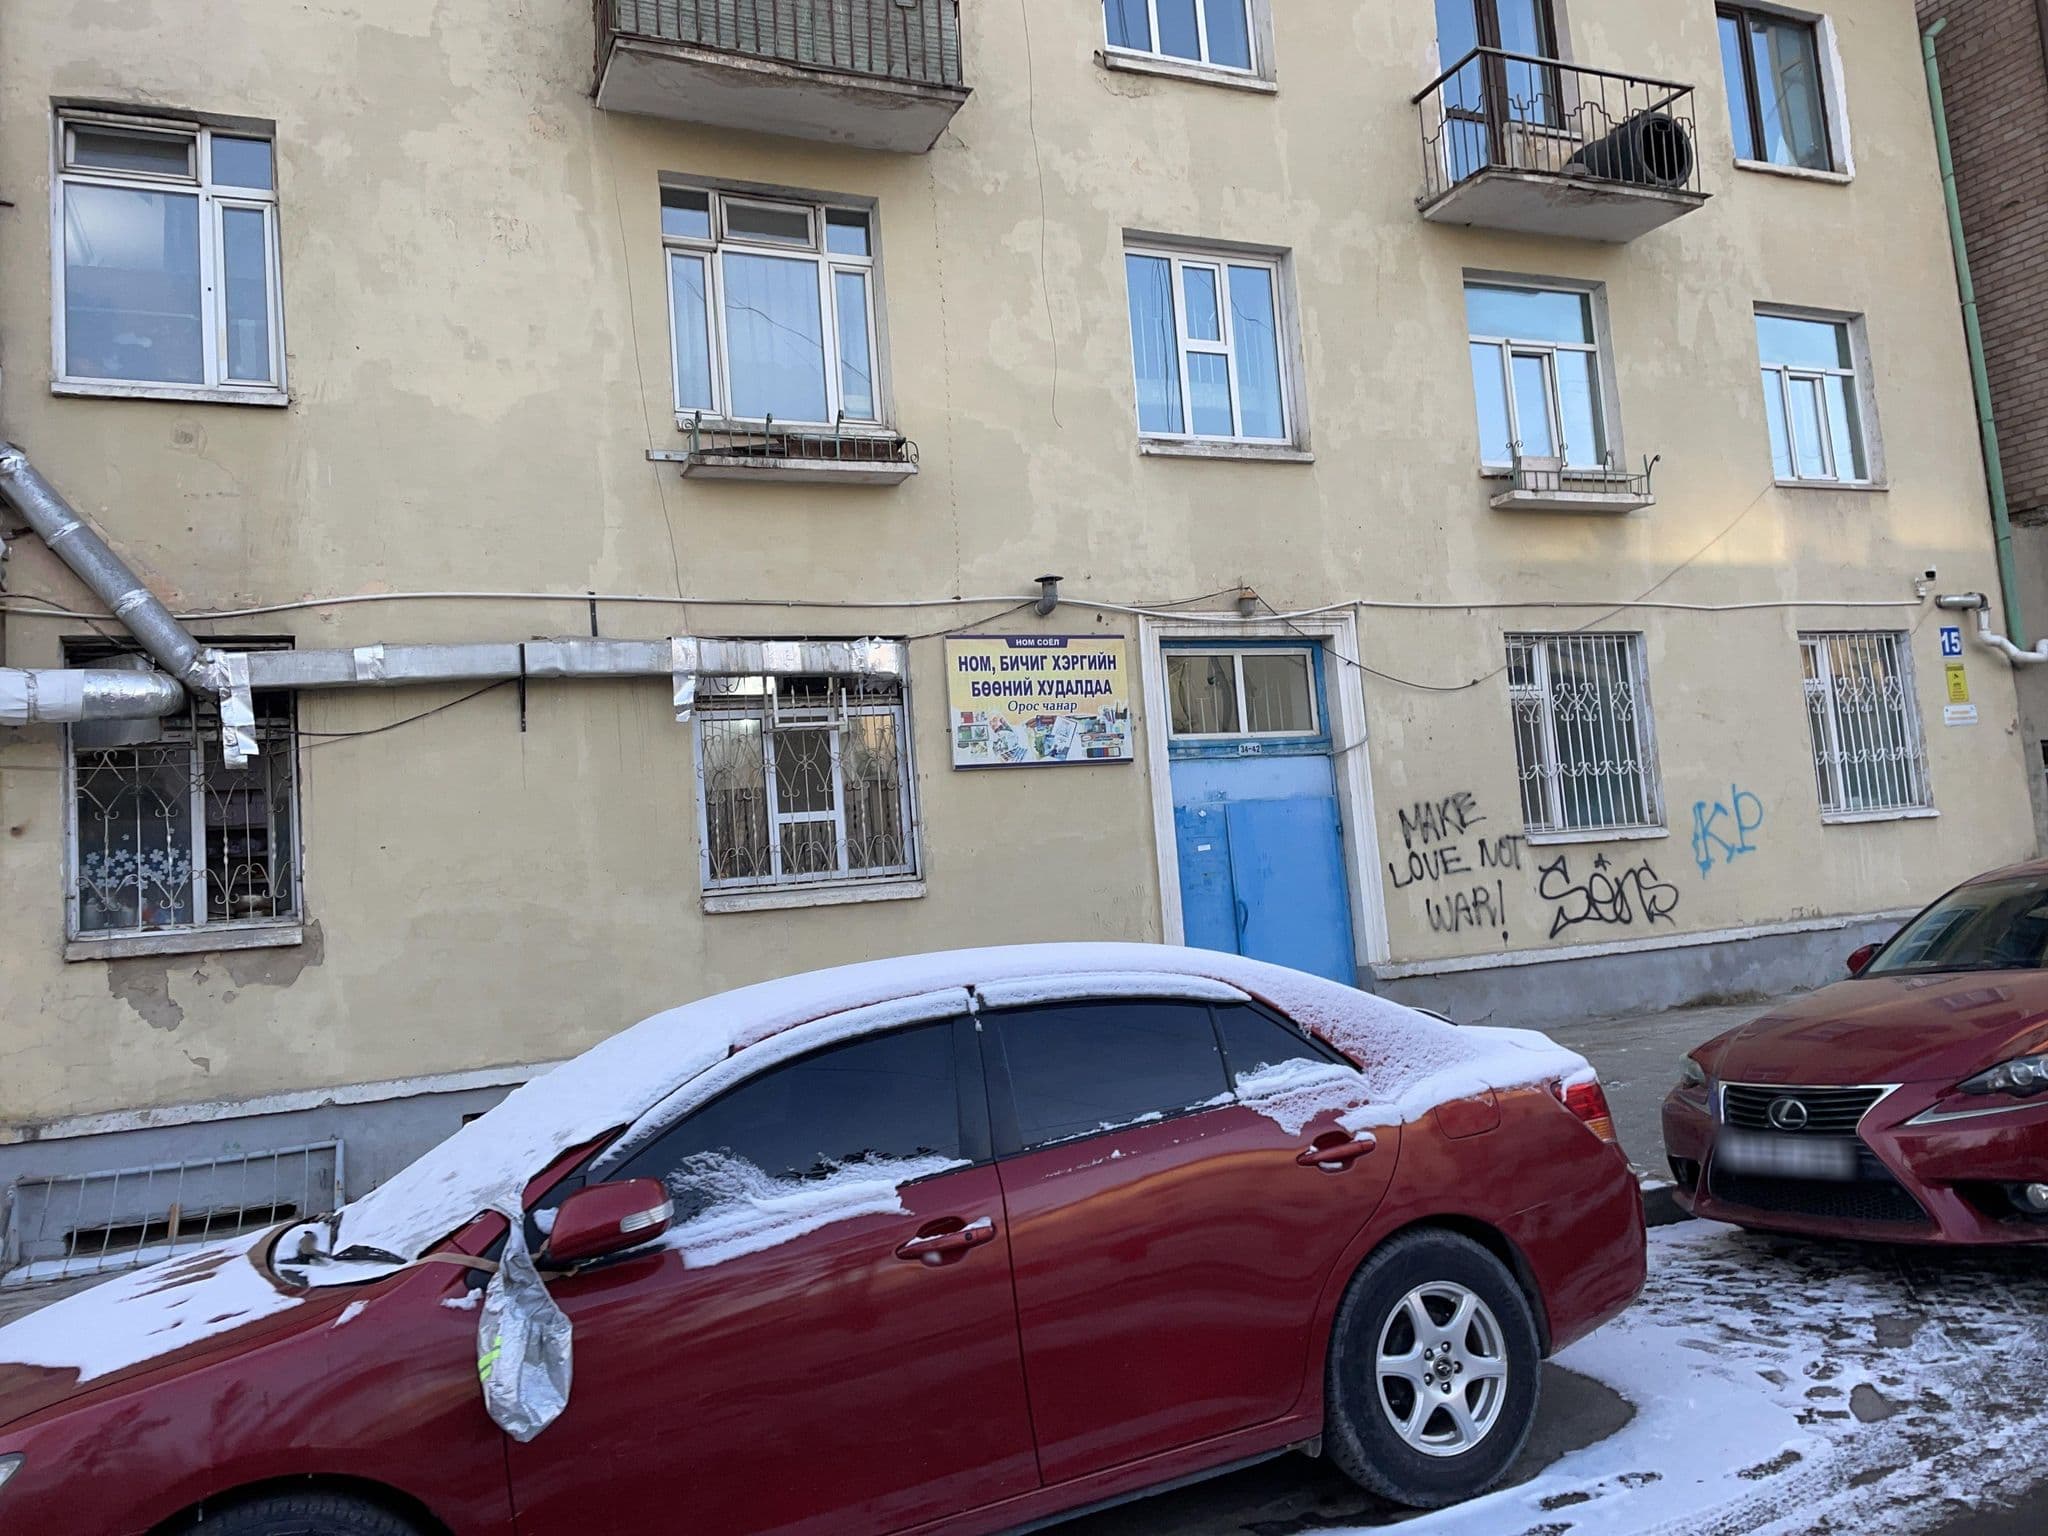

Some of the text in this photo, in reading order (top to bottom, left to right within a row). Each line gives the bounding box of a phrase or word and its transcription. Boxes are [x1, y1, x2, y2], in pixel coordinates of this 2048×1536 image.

[1015, 638, 1035, 647] НОМ
[1941, 631, 1961, 653] 15
[958, 651, 1117, 675] НОМ, БИЧИГ ХЭРГИЙН
[971, 676, 1113, 698] БӨӨНИЙ ХУДАЛДАА
[1008, 700, 1078, 714] Орос чанар
[1399, 792, 1487, 849] MAKE
[1388, 834, 1525, 888] LOVE NOT
[1426, 879, 1509, 948] WAR!
